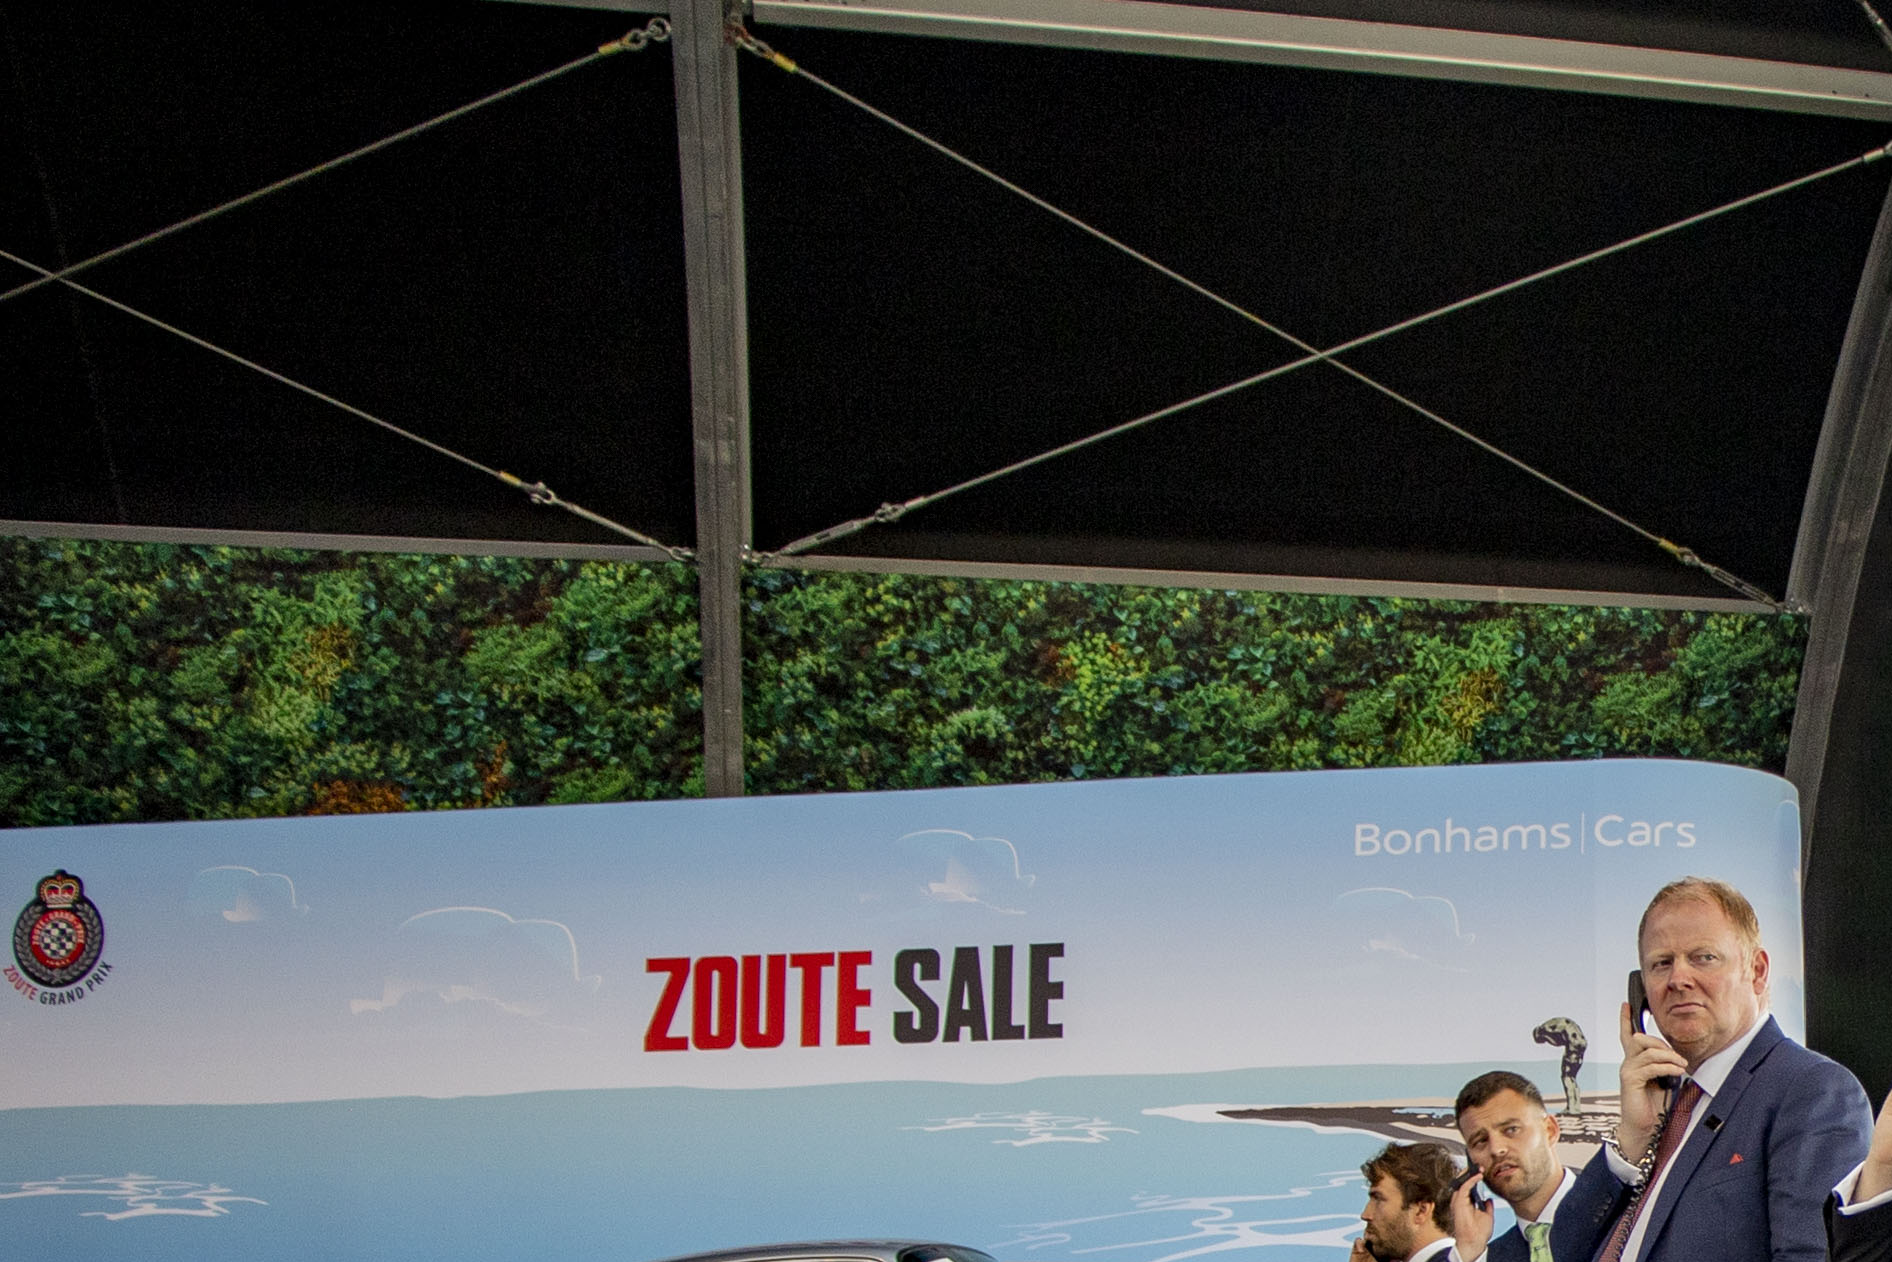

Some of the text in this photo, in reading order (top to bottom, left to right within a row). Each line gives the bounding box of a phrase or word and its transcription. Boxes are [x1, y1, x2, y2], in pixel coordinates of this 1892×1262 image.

[1353, 814, 1697, 856] Bonhams Cars
[3, 961, 113, 1005] ZOUTE GRAND PRIX
[643, 942, 1065, 1052] ZOUTE SALE
